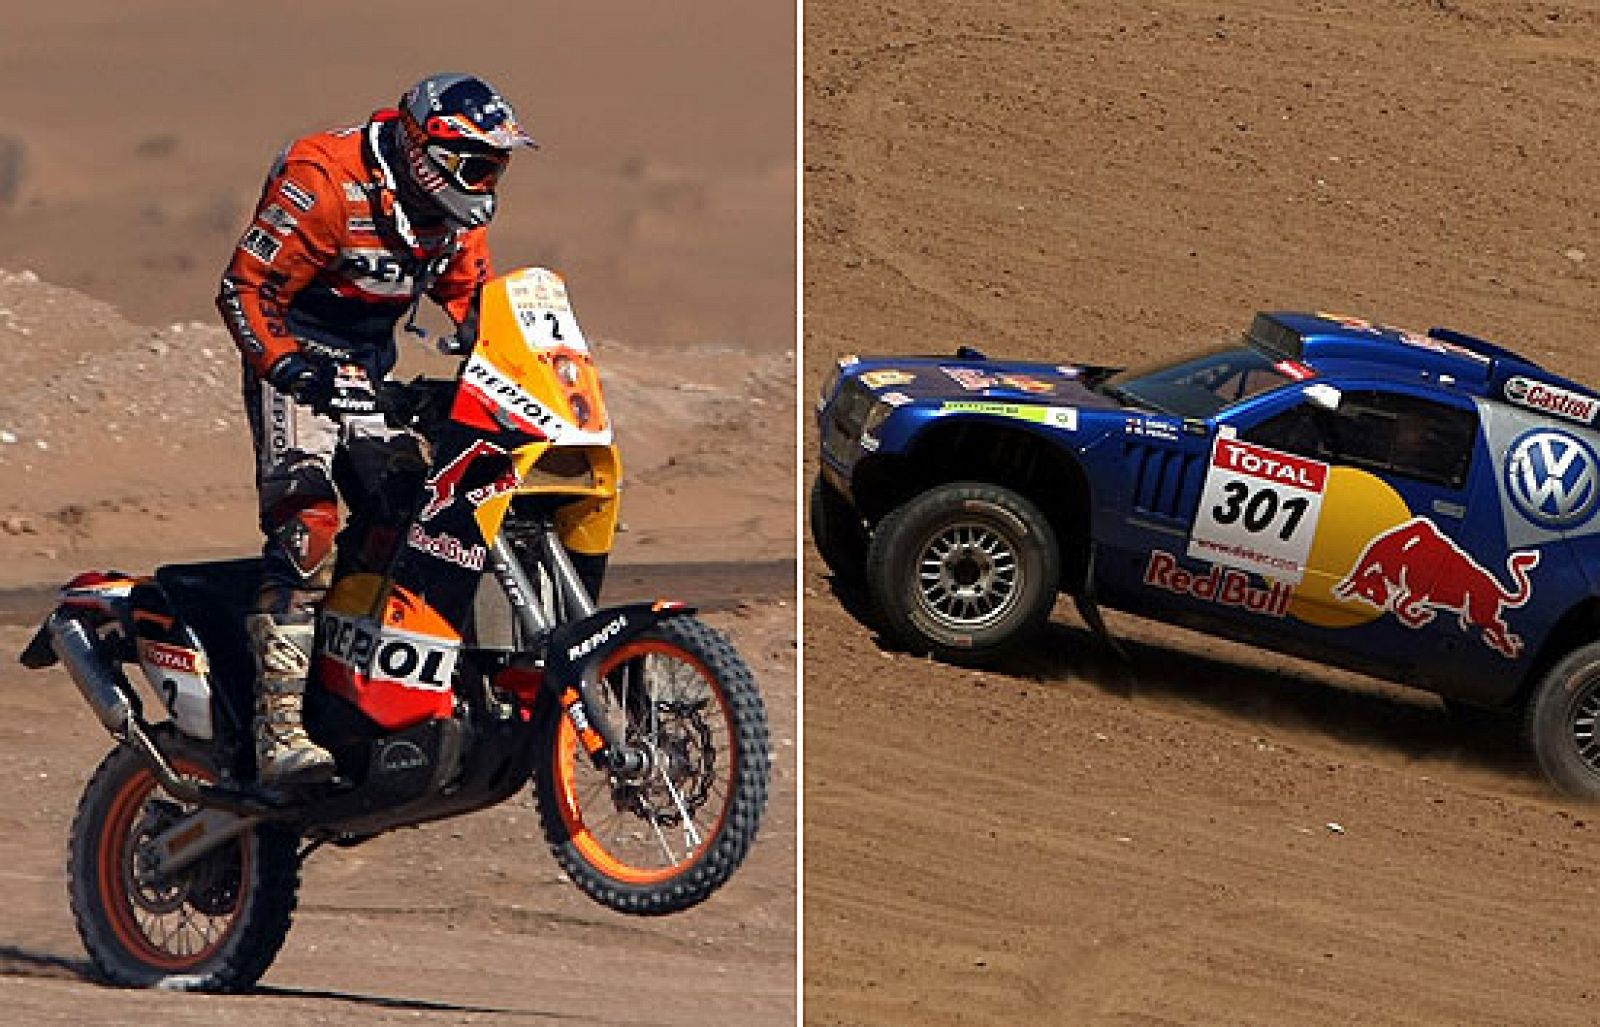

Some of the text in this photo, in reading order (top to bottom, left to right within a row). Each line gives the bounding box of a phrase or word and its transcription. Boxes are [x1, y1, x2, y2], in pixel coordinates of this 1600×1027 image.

[543, 310, 566, 341] 2
[1527, 385, 1594, 420] Castrol
[1225, 444, 1315, 487] TOTAL
[1212, 479, 1310, 542] 301
[1144, 549, 1296, 618] Red Bull
[163, 677, 179, 719] 2
